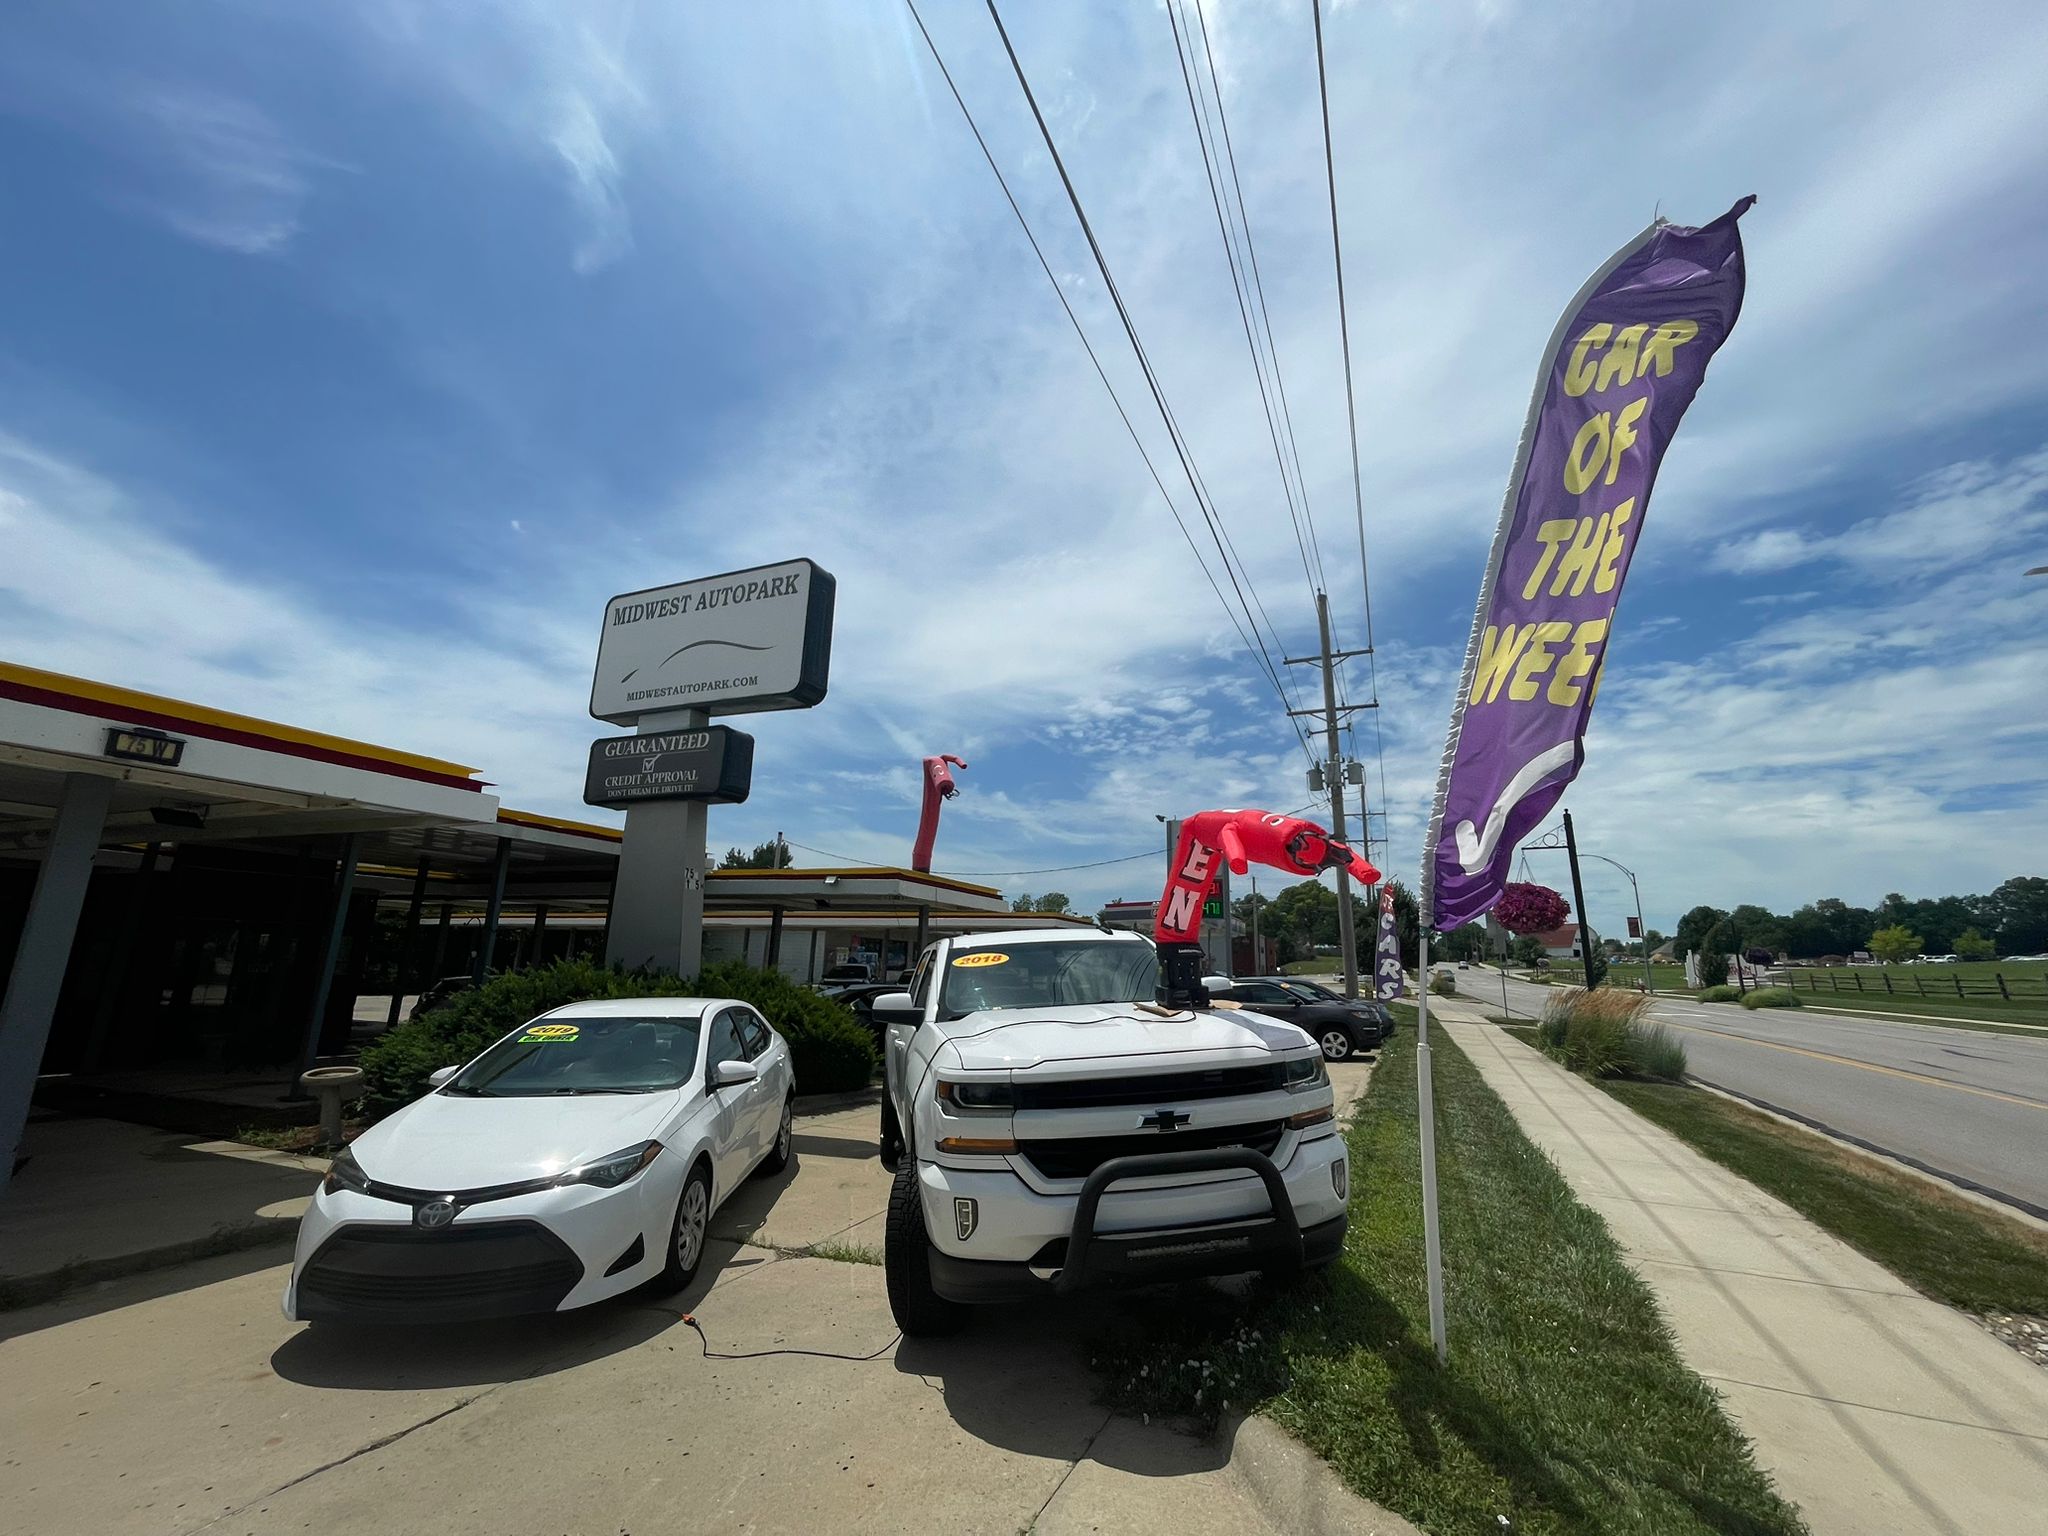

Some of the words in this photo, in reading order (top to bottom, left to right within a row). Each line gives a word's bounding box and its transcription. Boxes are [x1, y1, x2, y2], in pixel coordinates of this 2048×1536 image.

[1563, 318, 1699, 398] CAR
[1563, 396, 1648, 495] OF
[1521, 495, 1636, 600] THE
[613, 594, 692, 626] MIDWEST
[694, 573, 800, 611] AUTOPARK
[1469, 614, 1608, 708] WEE
[626, 675, 759, 702] MIDWESTAUTOPARK.COM
[605, 732, 710, 757] GUARANTEED
[605, 774, 643, 787] CREDIT
[645, 769, 698, 784] APPROVAL
[960, 954, 1002, 965] 2018
[1378, 912, 1400, 999] CARS
[532, 1026, 574, 1035] 2019
